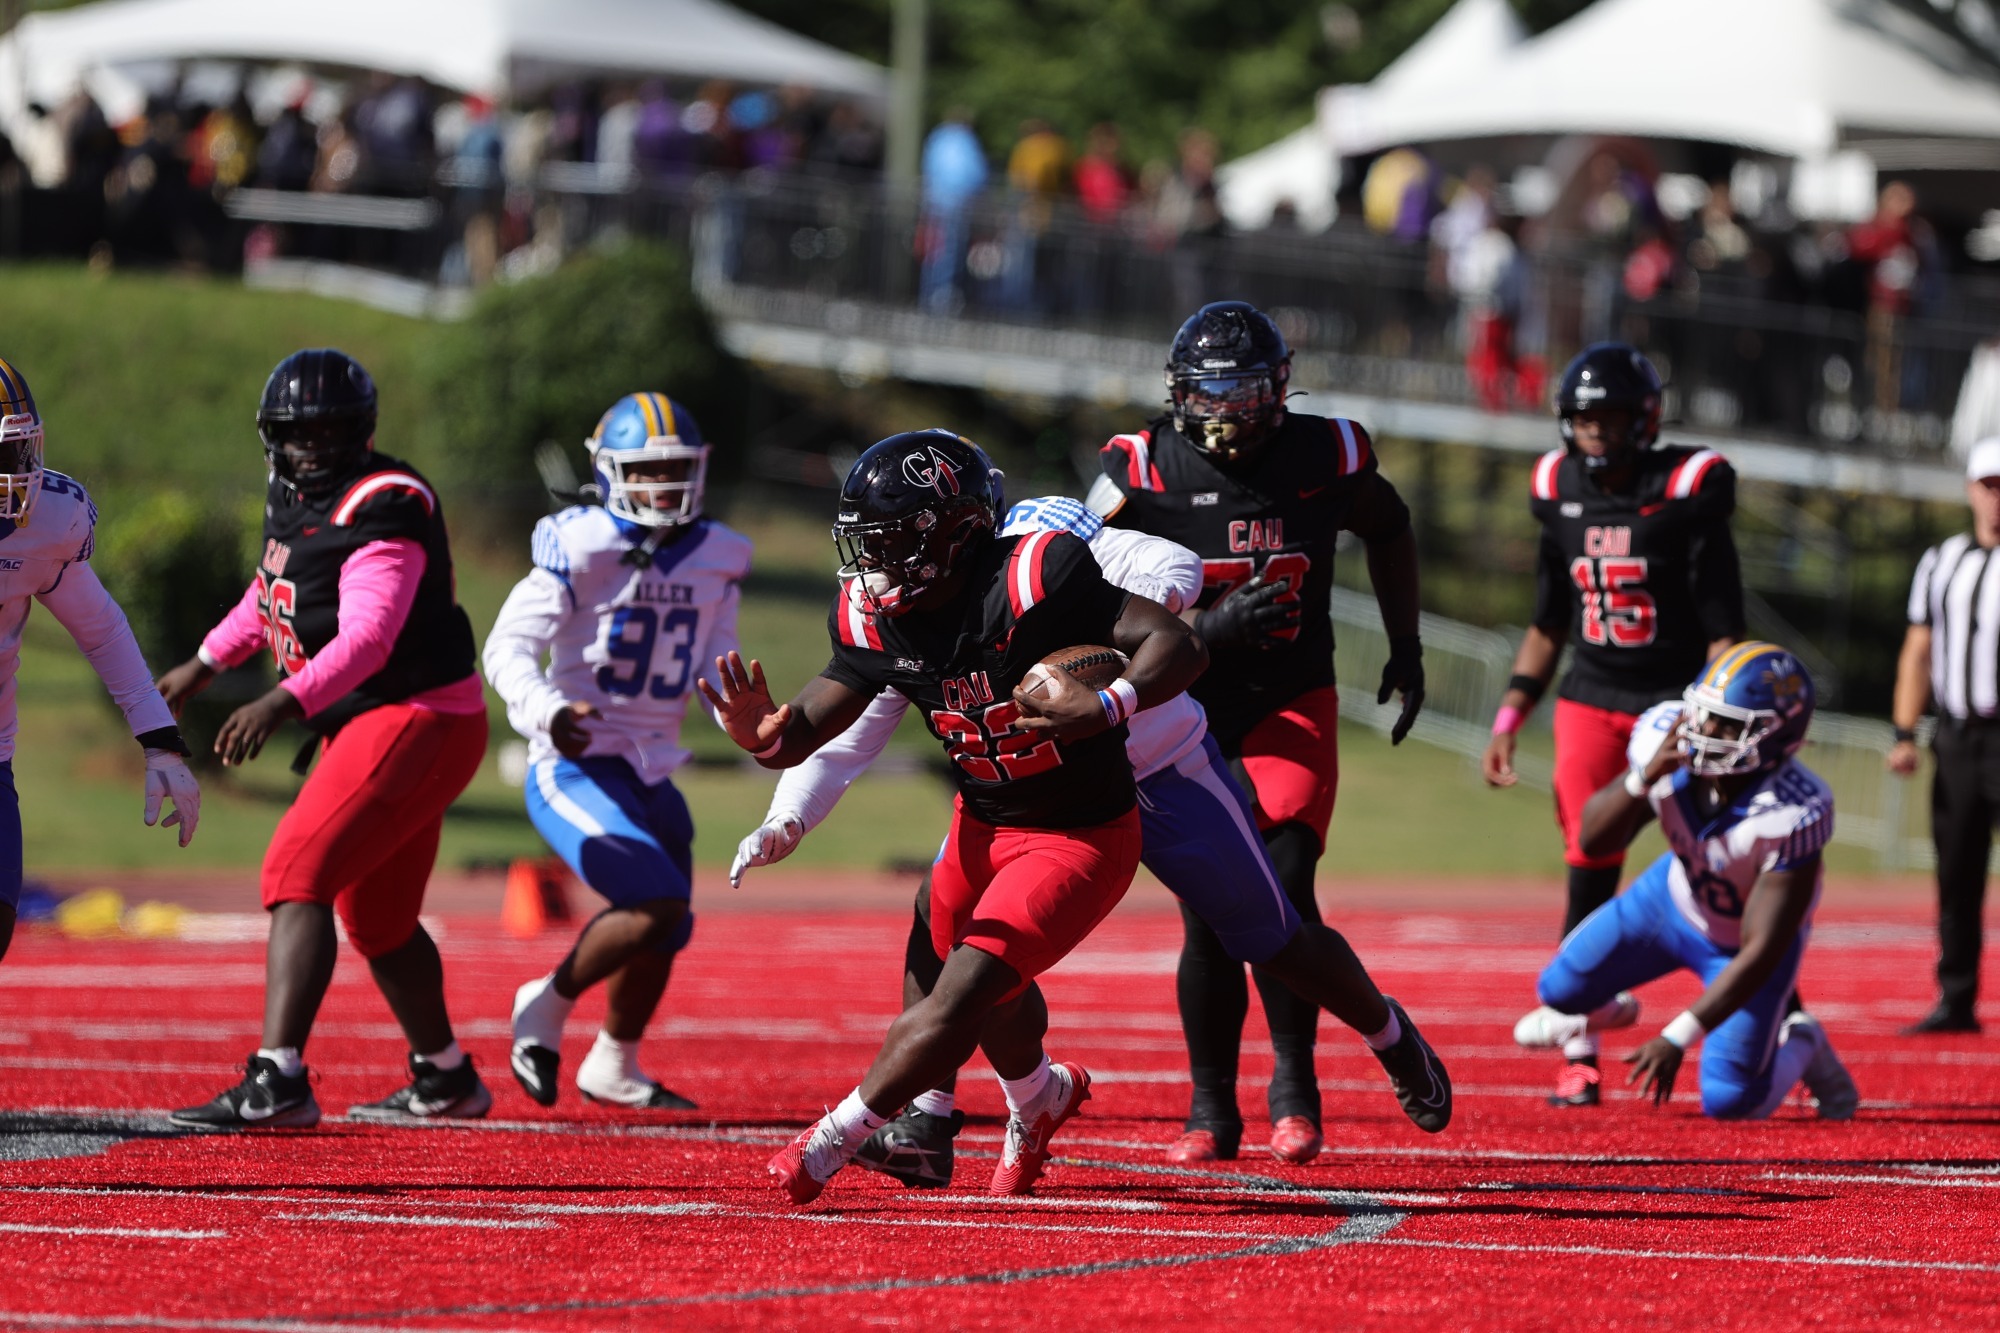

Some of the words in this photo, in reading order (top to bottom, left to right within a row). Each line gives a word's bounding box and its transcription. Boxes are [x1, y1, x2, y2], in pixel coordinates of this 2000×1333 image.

[1228, 518, 1284, 553] CAU
[1584, 526, 1630, 557] CAU
[262, 537, 292, 577] CAU
[634, 582, 694, 605] ALLEN
[1570, 557, 1657, 647] 15
[596, 606, 698, 699] 93
[942, 671, 994, 711] CAU
[931, 701, 1063, 783] 22
[1773, 768, 1819, 806] 48
